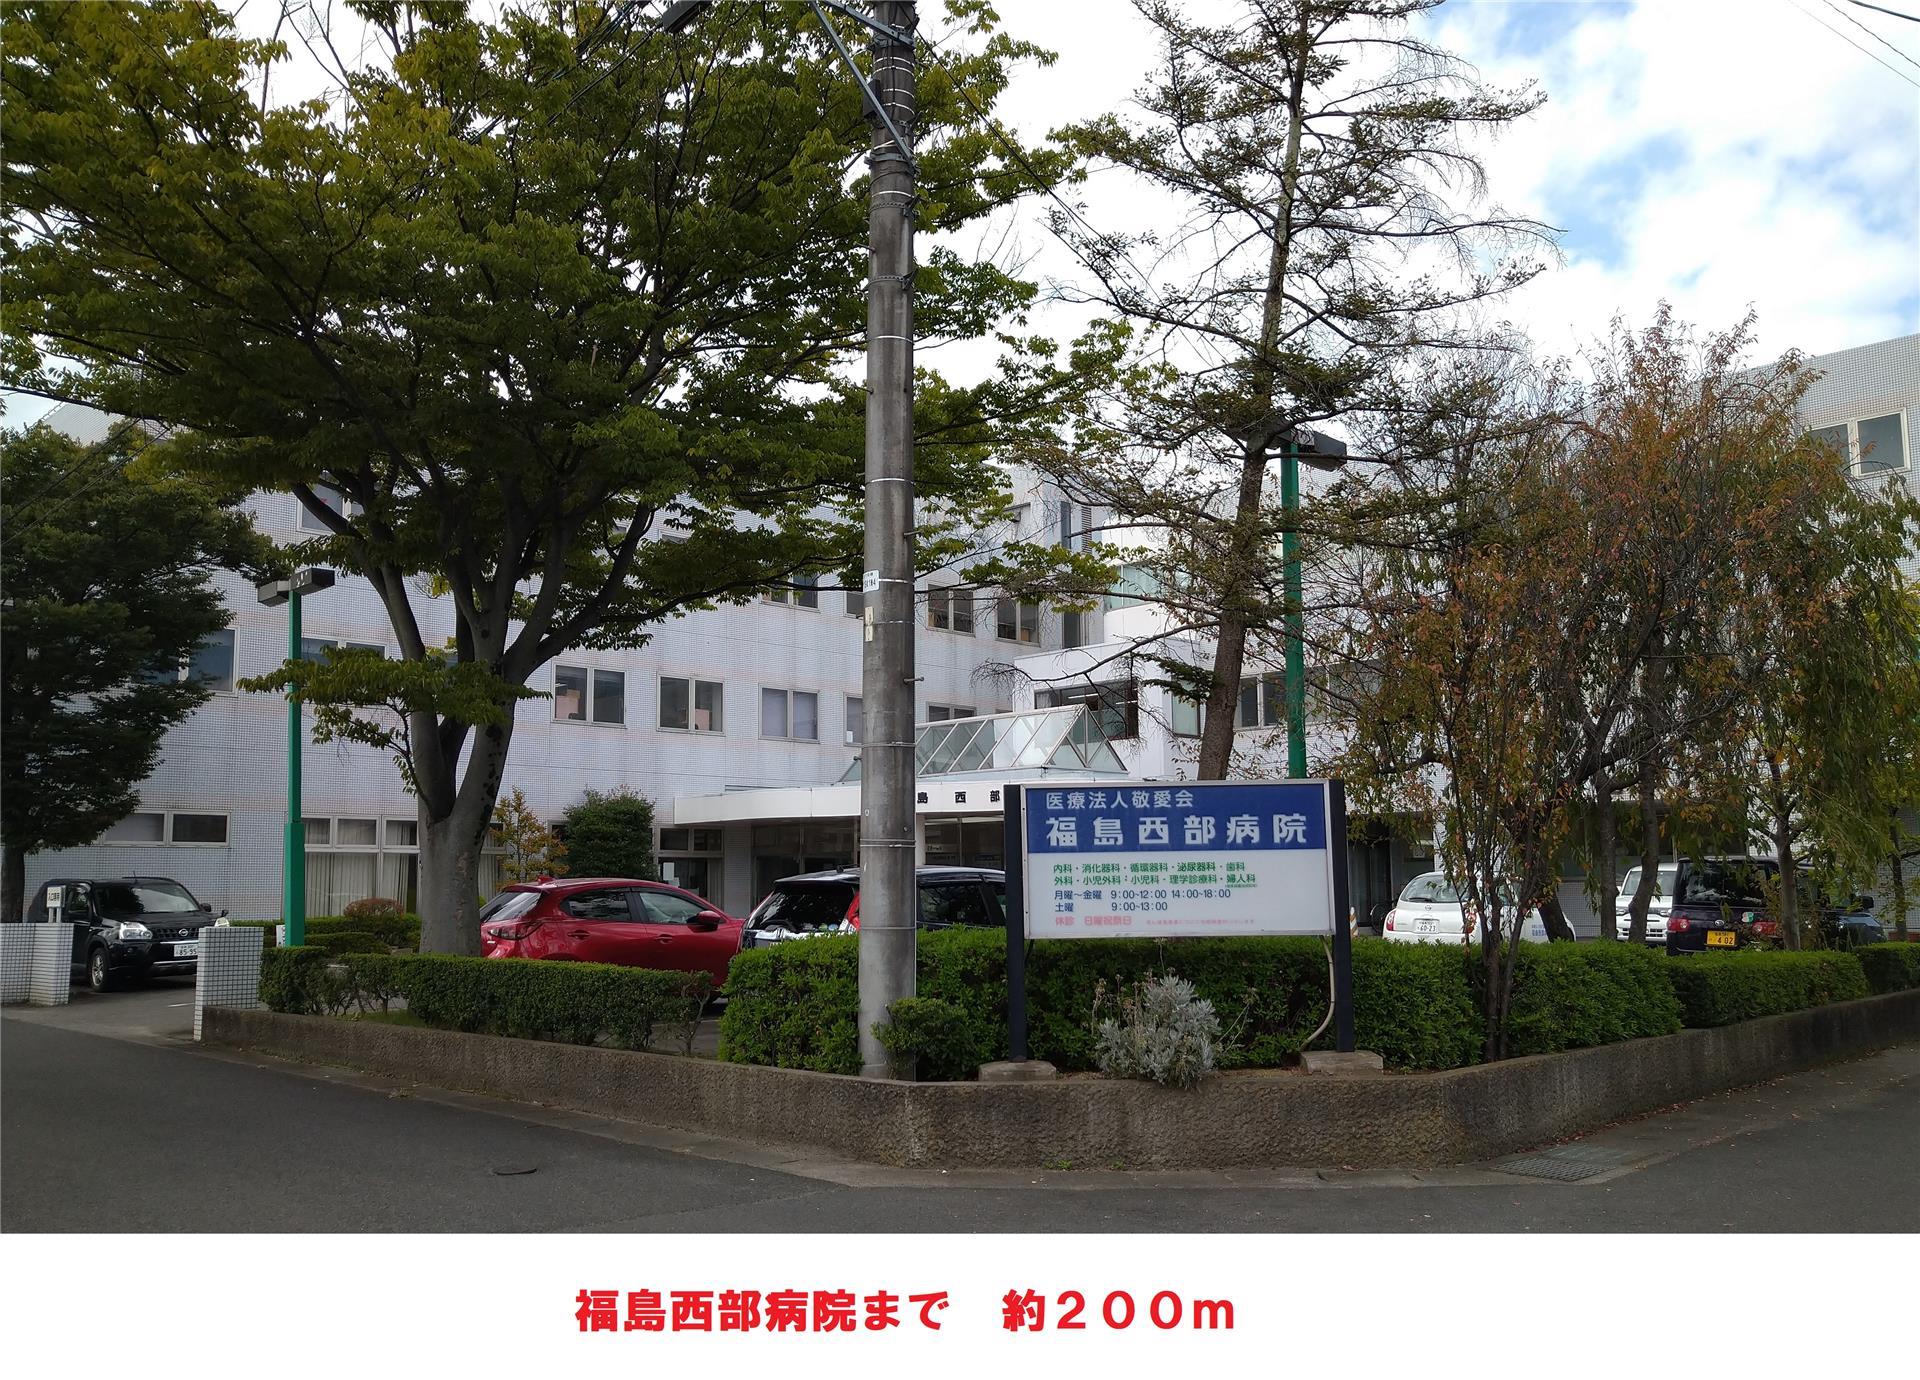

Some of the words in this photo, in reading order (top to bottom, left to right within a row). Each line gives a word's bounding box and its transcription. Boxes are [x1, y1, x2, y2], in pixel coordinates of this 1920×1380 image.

[1046, 789, 1194, 809] 医療法人敬愛会
[1046, 813, 1307, 847] 福島西部病院
[1055, 903, 1074, 912] 土曜
